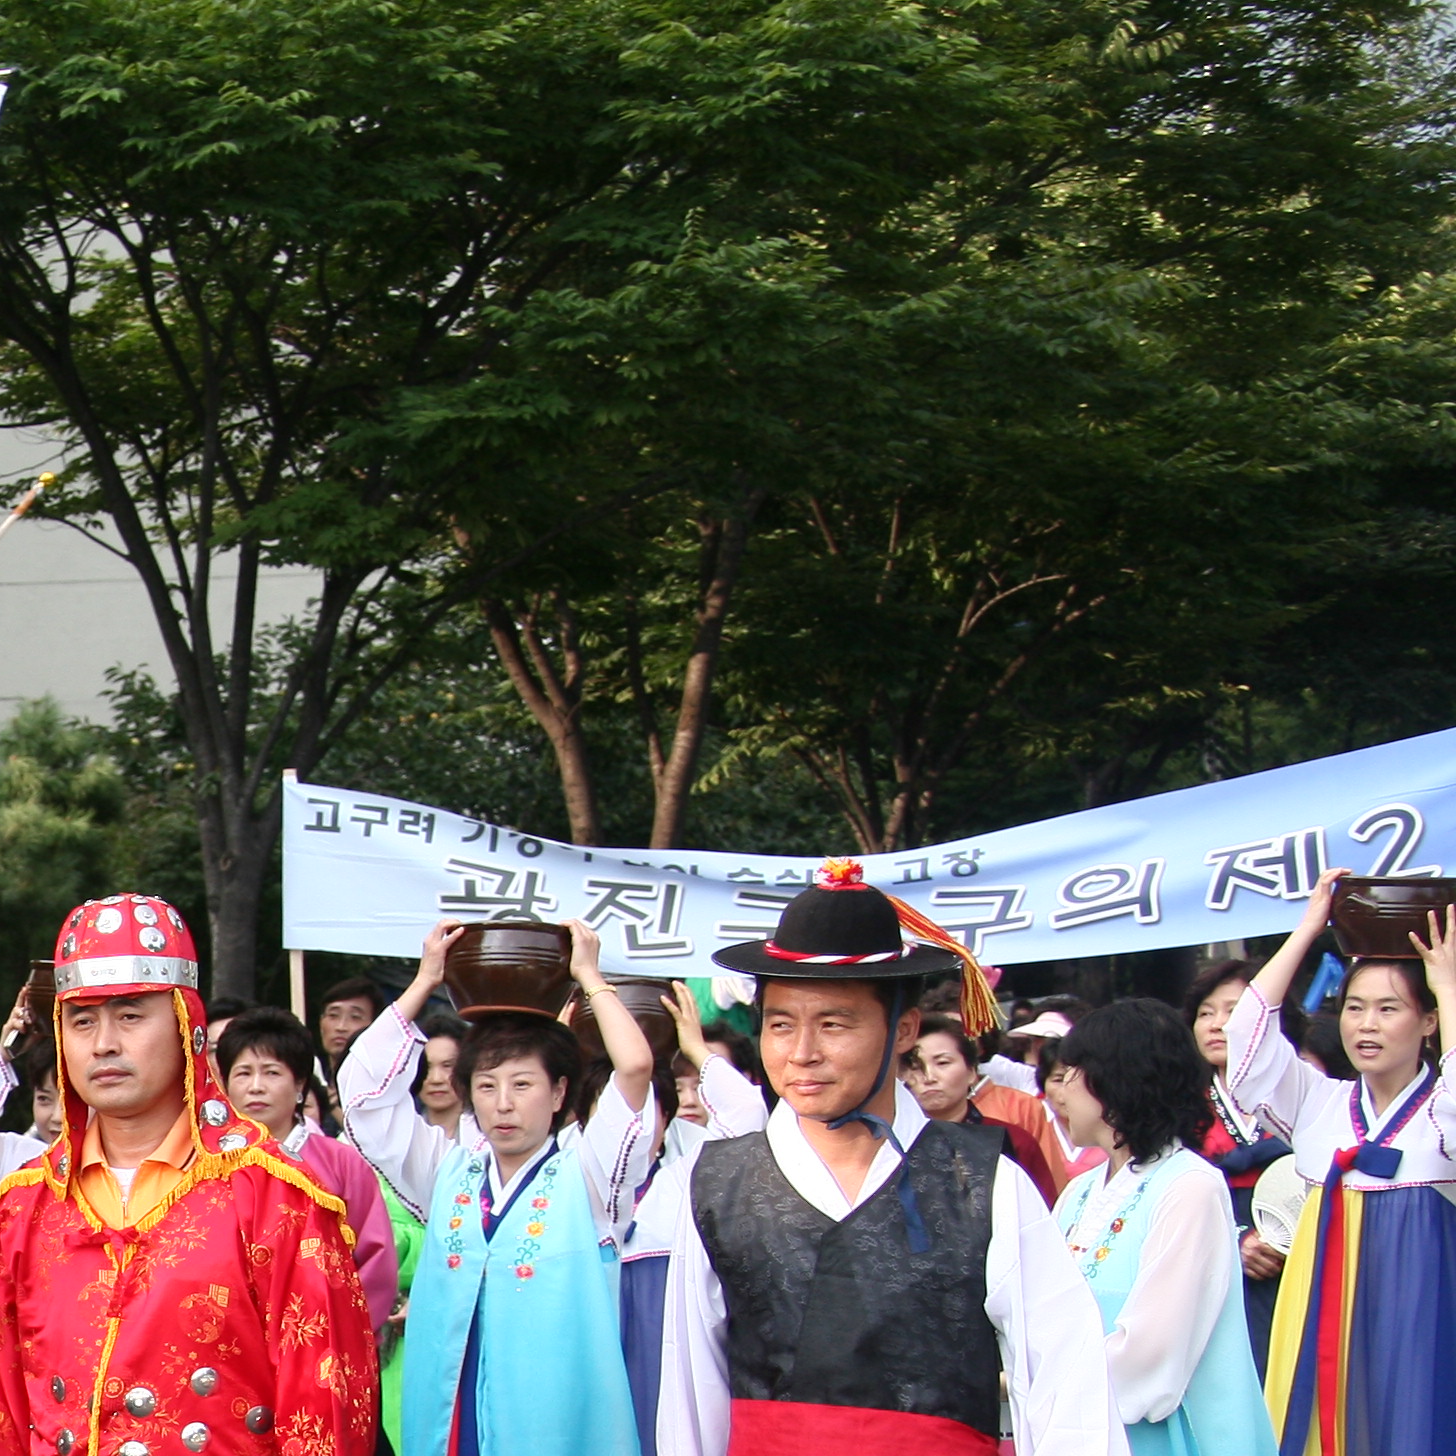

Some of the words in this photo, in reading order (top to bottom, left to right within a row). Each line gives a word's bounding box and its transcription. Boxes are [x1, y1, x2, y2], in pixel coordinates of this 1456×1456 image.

[303, 797, 436, 844] 고구려
[892, 847, 985, 886] 고장
[931, 857, 1162, 956] 구의
